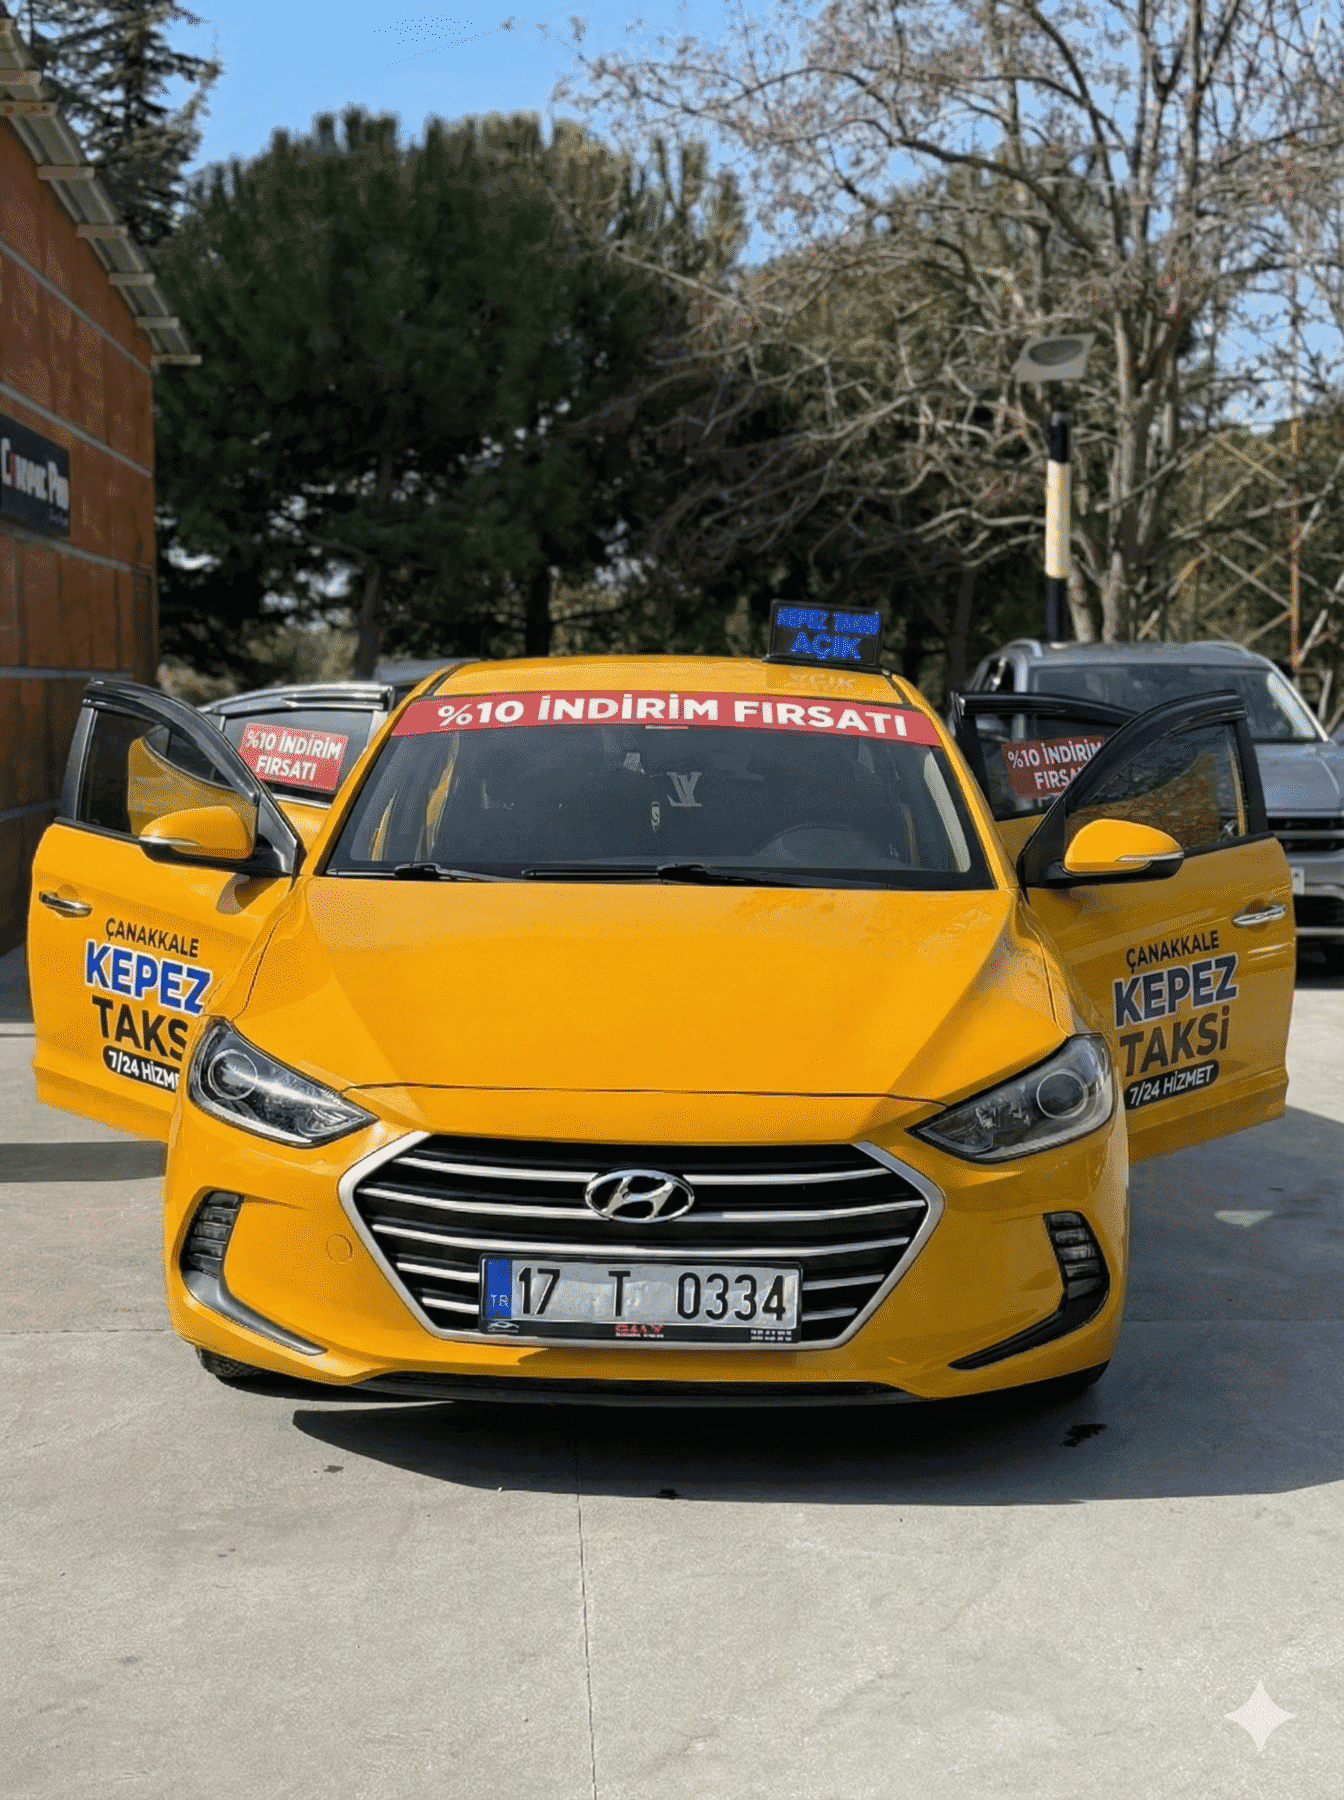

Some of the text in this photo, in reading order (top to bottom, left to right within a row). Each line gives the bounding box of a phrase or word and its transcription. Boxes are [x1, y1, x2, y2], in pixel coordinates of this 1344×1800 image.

[791, 631, 861, 659] AÇIK
[437, 693, 907, 737] %10 İNDİRİM FIRSATI
[247, 730, 342, 760] %10 İNDİRİM
[1007, 748, 1041, 769] %10
[255, 755, 317, 781] FIRSATI
[105, 917, 199, 958] ÇANAKKALE
[1126, 930, 1220, 974] ÇANAKKALE
[85, 938, 212, 1017] KEPEZ
[1113, 952, 1240, 1029] KEPEZ
[1119, 1004, 1230, 1077] TAKSİ
[108, 1050, 140, 1077] 7/24
[1129, 1065, 1215, 1106] 7/24 HİZMET
[490, 1293, 510, 1308] TR
[518, 1267, 786, 1322] 17 T 0334
